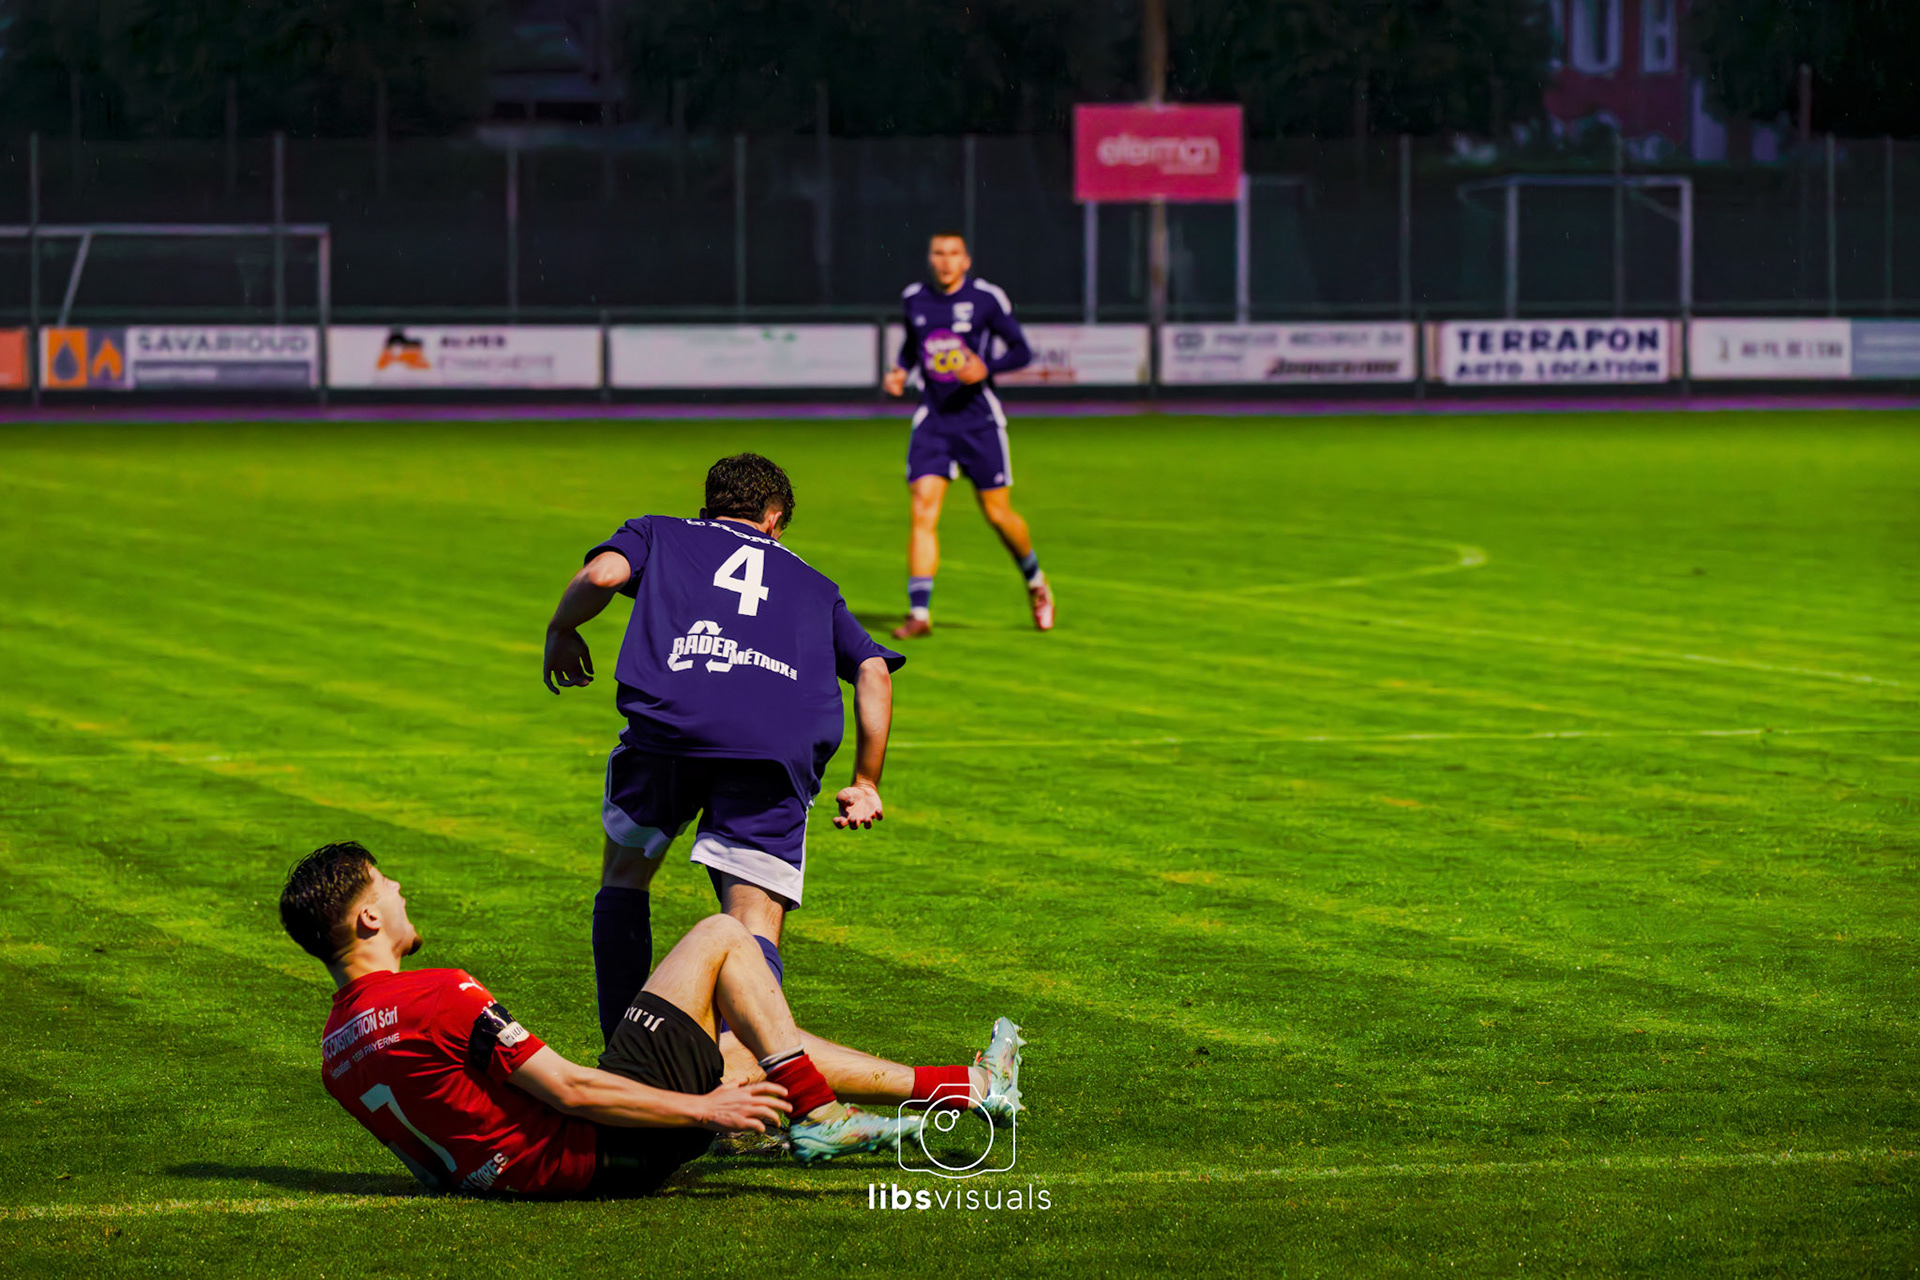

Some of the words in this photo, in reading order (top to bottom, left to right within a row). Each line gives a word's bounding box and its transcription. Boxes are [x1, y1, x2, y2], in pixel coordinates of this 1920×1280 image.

[1457, 328, 1660, 351] TERRAPON
[1456, 360, 1523, 377] AUTO
[1537, 359, 1660, 376] LOCATION
[713, 544, 769, 616] 4
[363, 1032, 401, 1057] PAYERNE
[360, 1082, 457, 1188] 7
